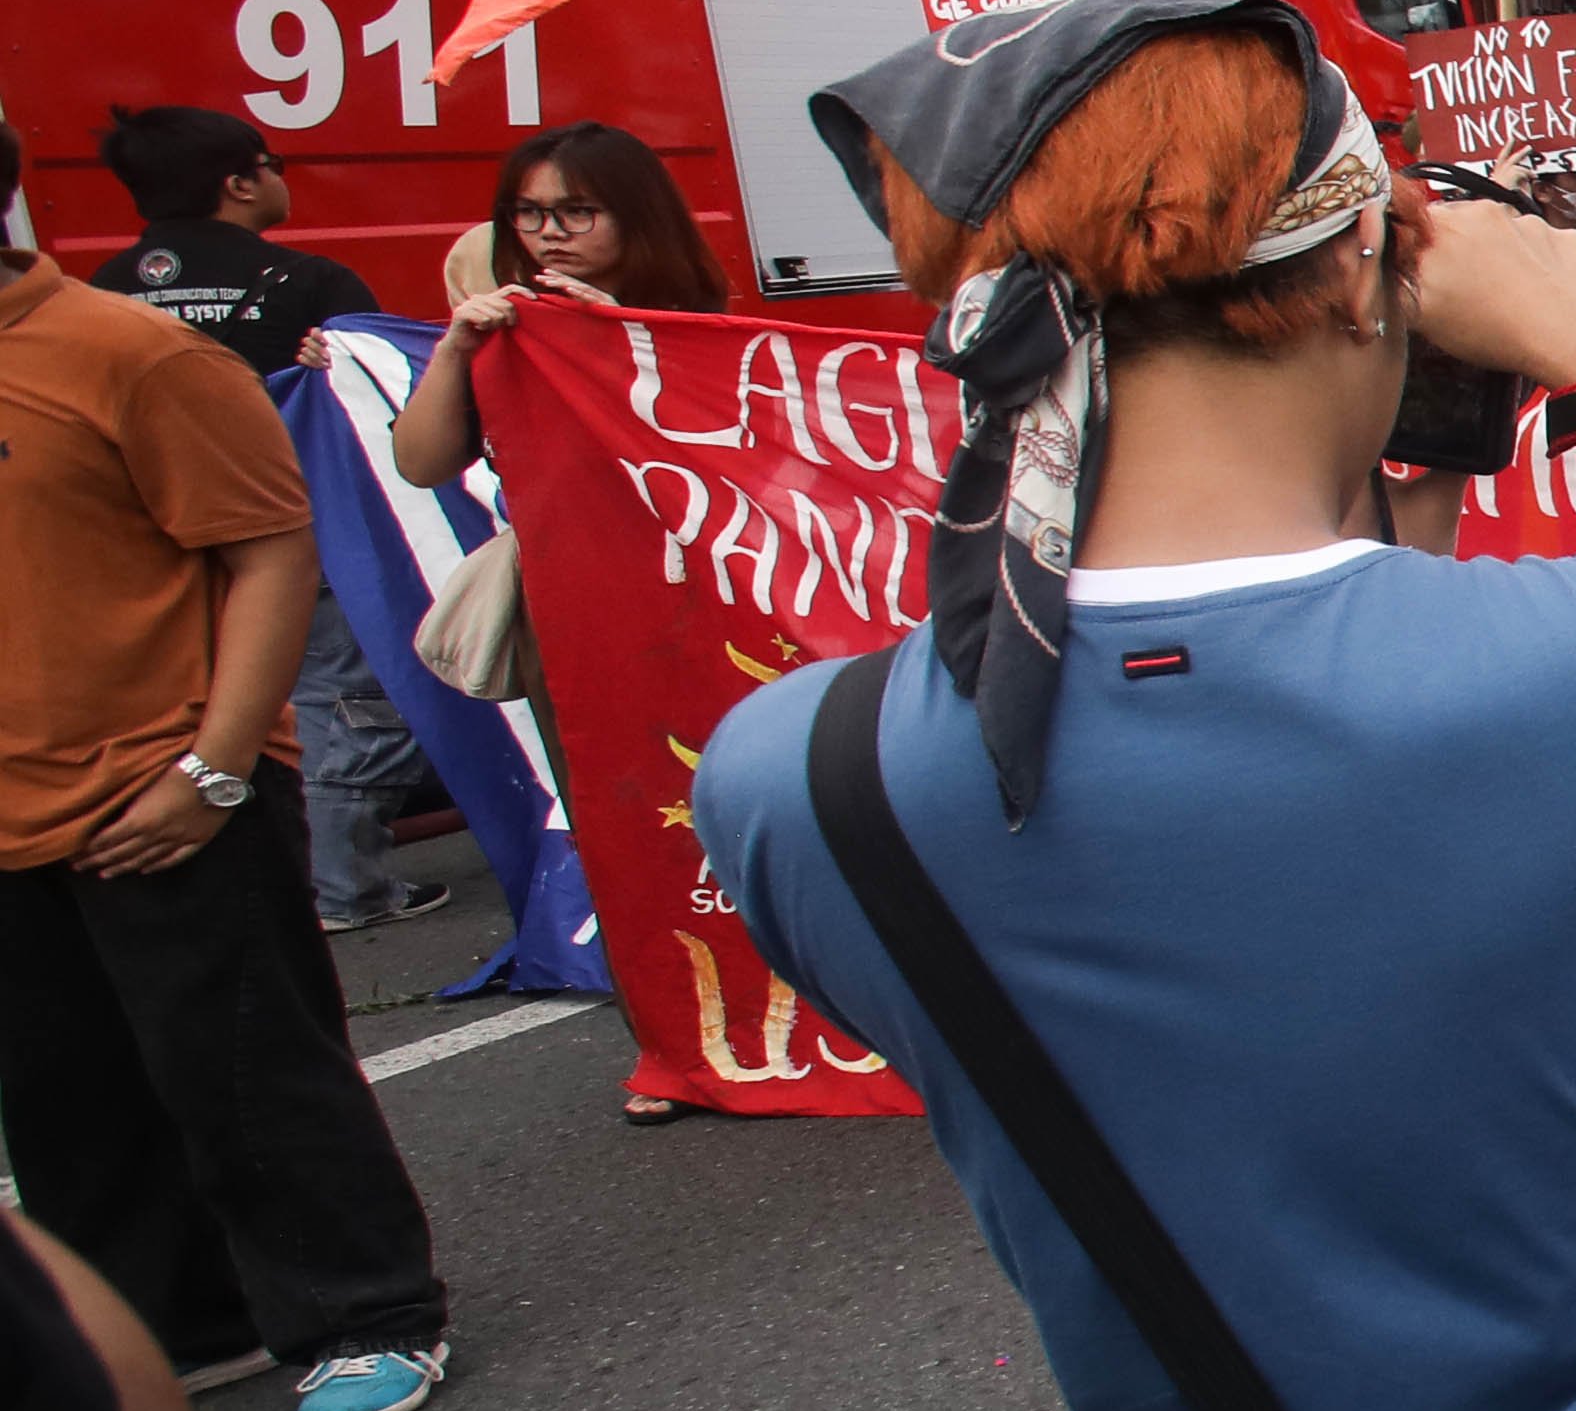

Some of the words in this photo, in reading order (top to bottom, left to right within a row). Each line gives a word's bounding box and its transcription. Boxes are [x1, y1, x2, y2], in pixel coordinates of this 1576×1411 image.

[1474, 25, 1508, 56] NO
[1520, 18, 1551, 47] TO
[1410, 54, 1535, 110] TUITION
